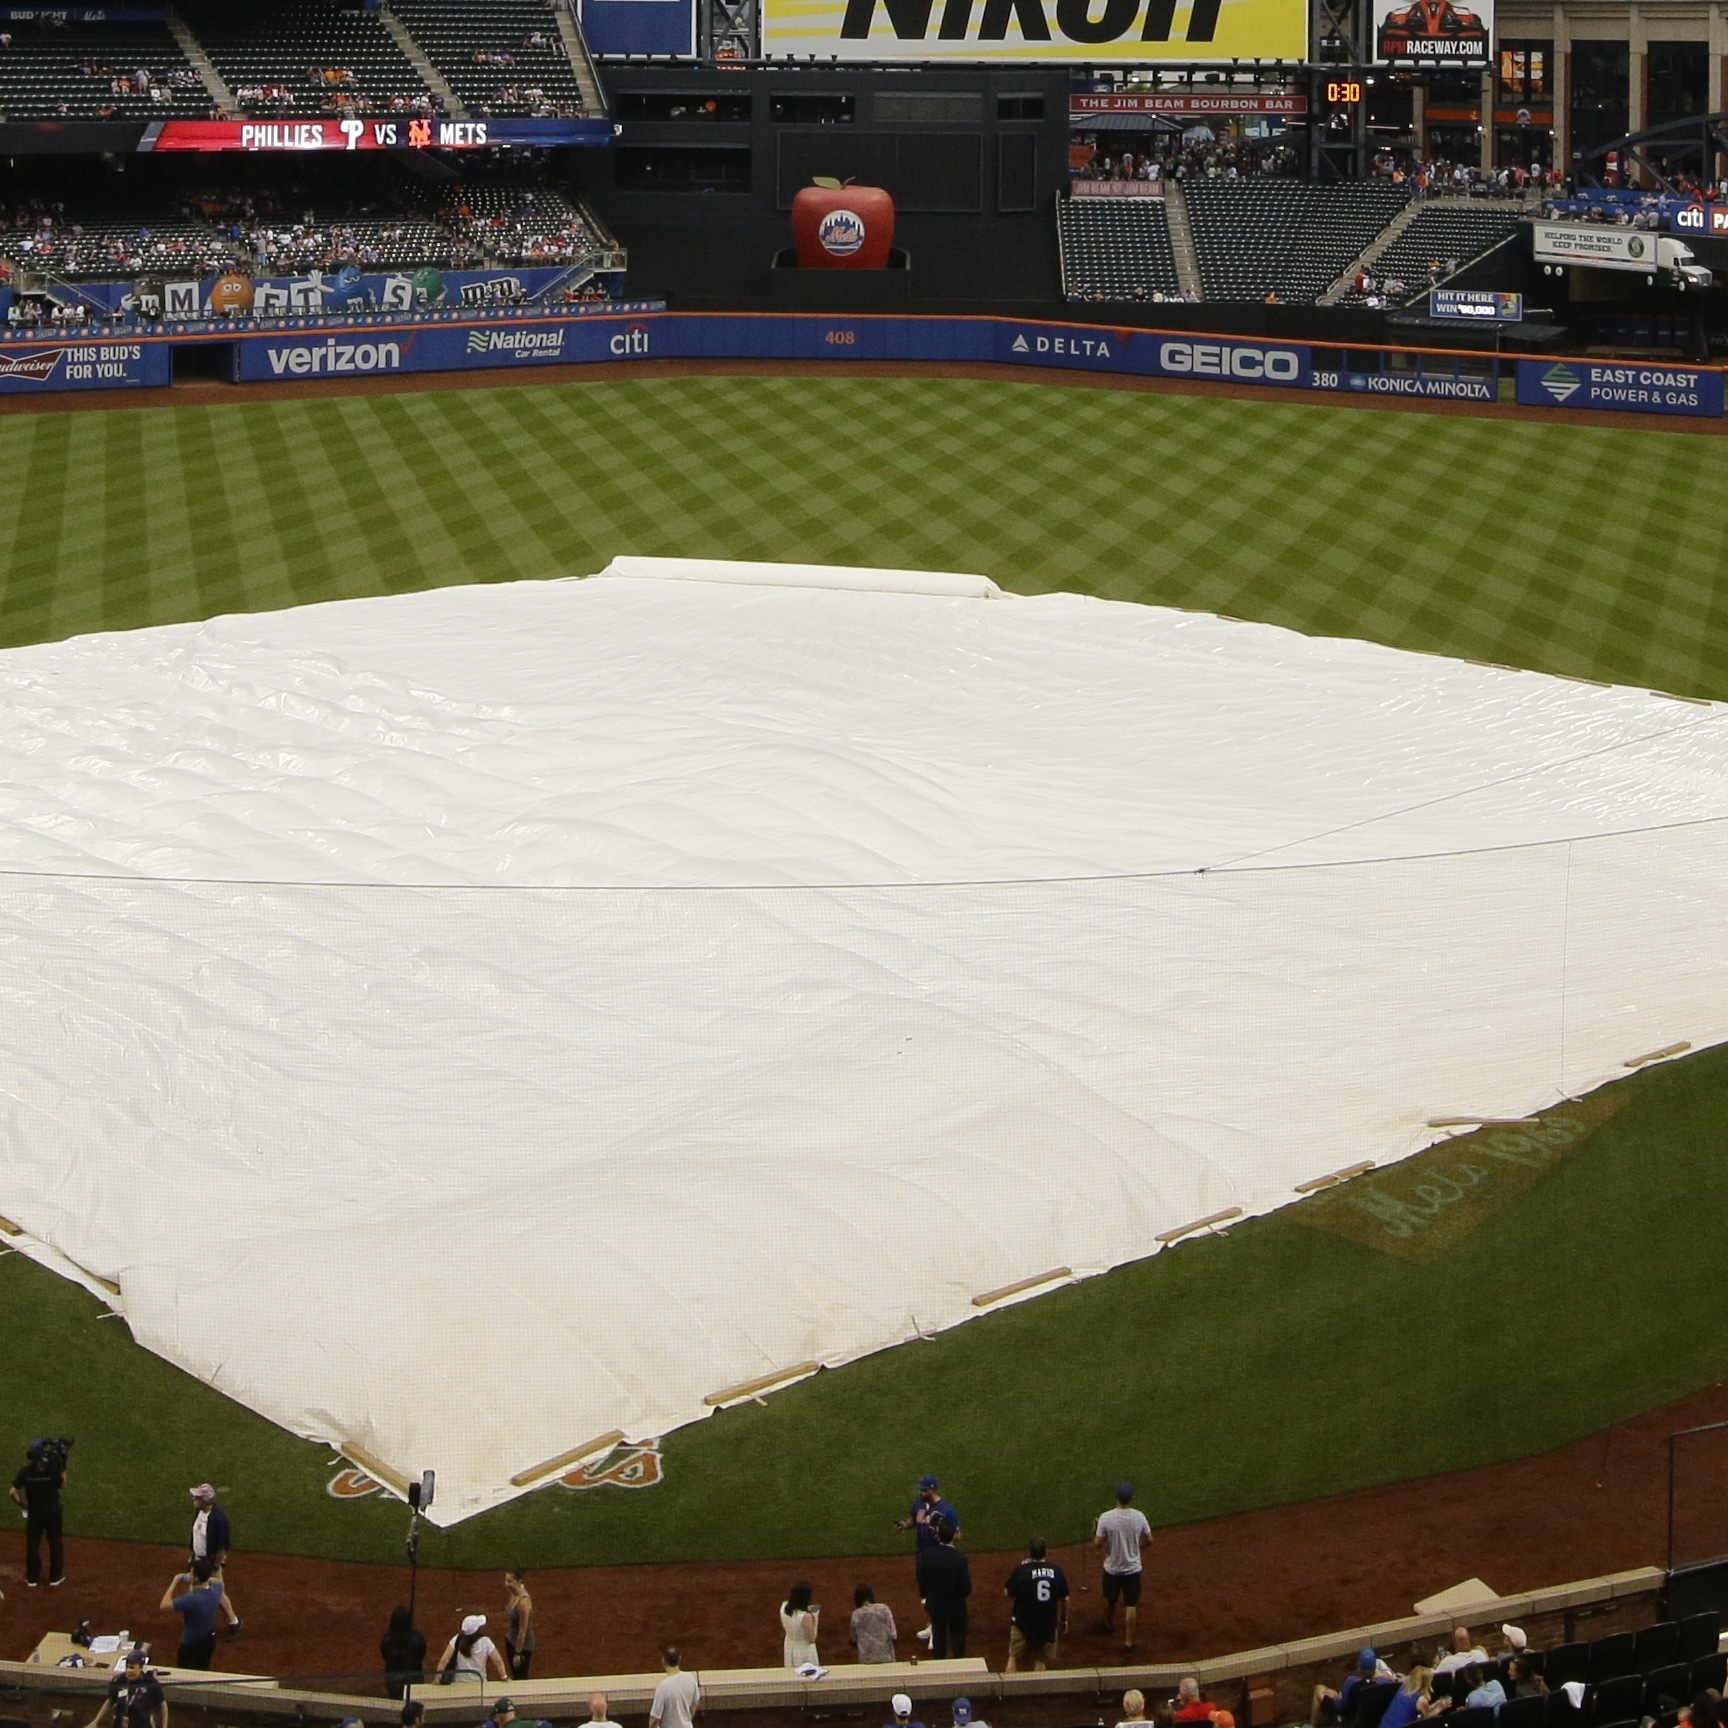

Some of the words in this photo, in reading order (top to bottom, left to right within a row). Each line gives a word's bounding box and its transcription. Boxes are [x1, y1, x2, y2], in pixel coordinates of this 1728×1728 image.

[1383, 40, 1483, 55] RPMRACEWAY.COM
[1328, 83, 1360, 102] 0:30
[1080, 98, 1109, 108] THE
[1114, 98, 1138, 108] JIM
[1145, 99, 1184, 108] BEAM
[1191, 99, 1258, 109] BOURBON
[1266, 99, 1293, 110] BAR
[1677, 209, 1704, 227] citi
[489, 329, 564, 350] National
[825, 331, 854, 344] 408
[66, 348, 97, 362] THIS
[100, 346, 141, 360] BUD'S
[268, 338, 400, 374] verizon
[533, 347, 560, 357] Rental
[1037, 337, 1110, 357] DELTA
[66, 363, 96, 379] FOR
[100, 362, 127, 377] YOU.
[1160, 343, 1299, 380] GEICO
[1312, 372, 1338, 387] 380
[1368, 376, 1423, 395] KONICA
[1426, 379, 1490, 398] MINOLTA
[1591, 369, 1635, 383] EAST
[1639, 372, 1698, 387] COAST
[1590, 387, 1647, 402] POWER
[1652, 390, 1661, 403] &
[1666, 391, 1698, 406] GAS
[1032, 1569, 1054, 1579] MARIO
[1037, 1581, 1050, 1601] 6
